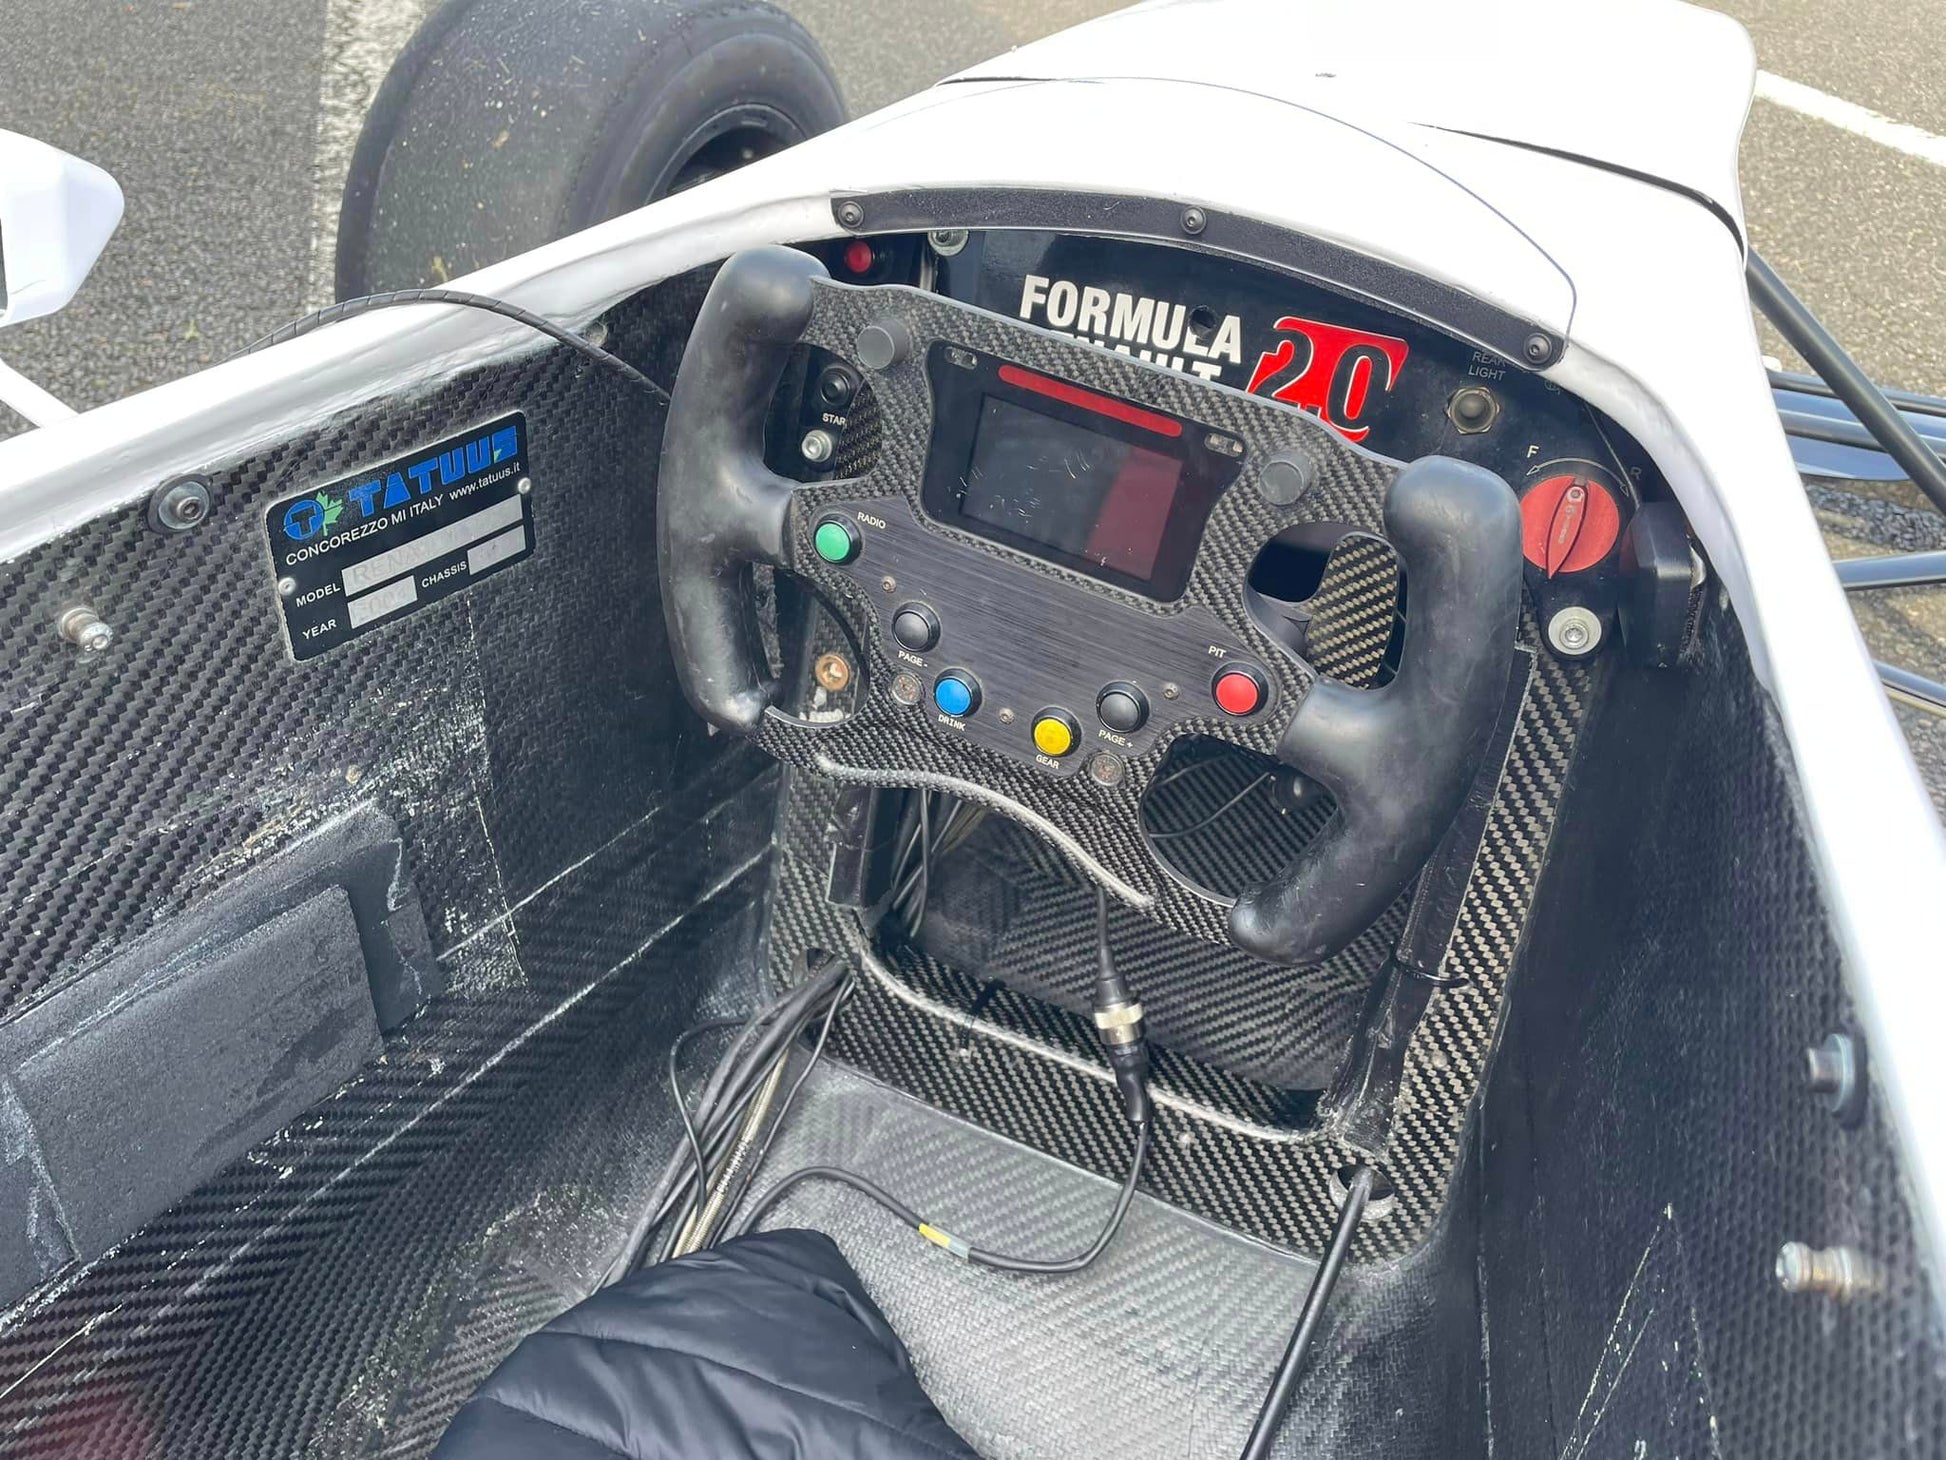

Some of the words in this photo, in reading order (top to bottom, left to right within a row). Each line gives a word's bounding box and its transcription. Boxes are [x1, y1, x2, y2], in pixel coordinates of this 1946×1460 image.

[1019, 274, 1241, 365] FORMULA
[1468, 364, 1507, 381] LIGHT
[822, 412, 847, 426] STAR
[1526, 445, 1539, 459] F
[348, 425, 519, 518] TATUUS
[285, 517, 389, 566] CONCOREZZO
[391, 511, 407, 526] MI
[409, 493, 444, 519] ITALY
[449, 461, 521, 501] www.tatuus.it
[857, 511, 886, 530] RADIO
[421, 560, 468, 589] CHASSIS
[295, 582, 341, 608] MODEL
[302, 618, 337, 641] YEAR
[1208, 645, 1227, 660] PIT
[938, 714, 967, 733] DRINK
[1036, 753, 1061, 770] GEAR
